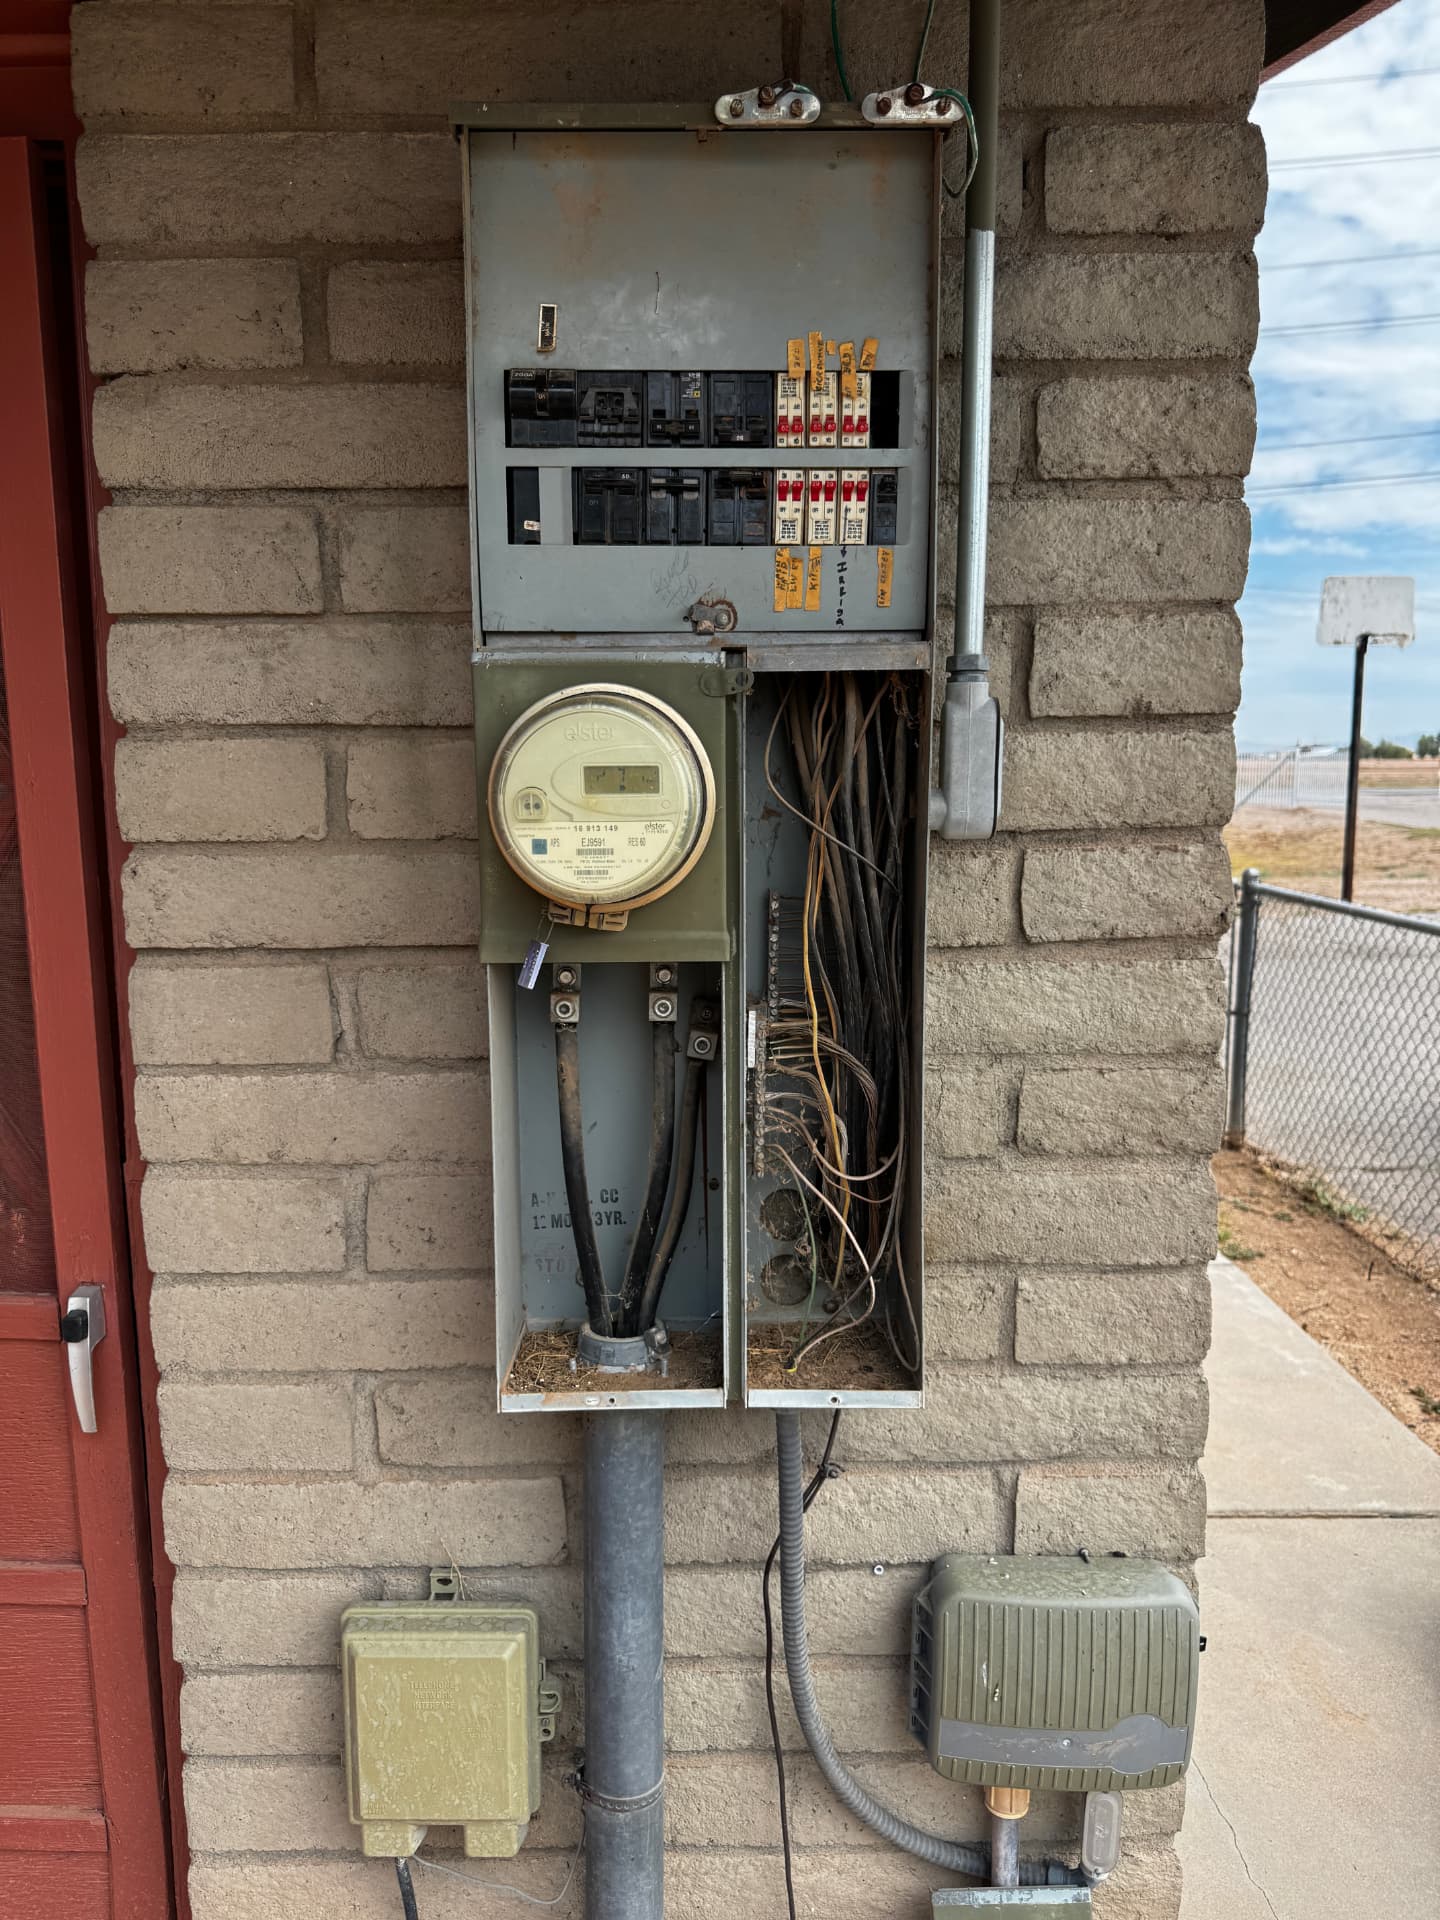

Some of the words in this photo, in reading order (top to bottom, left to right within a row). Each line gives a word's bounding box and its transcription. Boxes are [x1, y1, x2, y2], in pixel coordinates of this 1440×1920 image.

[564, 722, 616, 741] elster
[414, 1690, 453, 1699] NETWORK
[414, 1701, 457, 1710] INTERFACE
